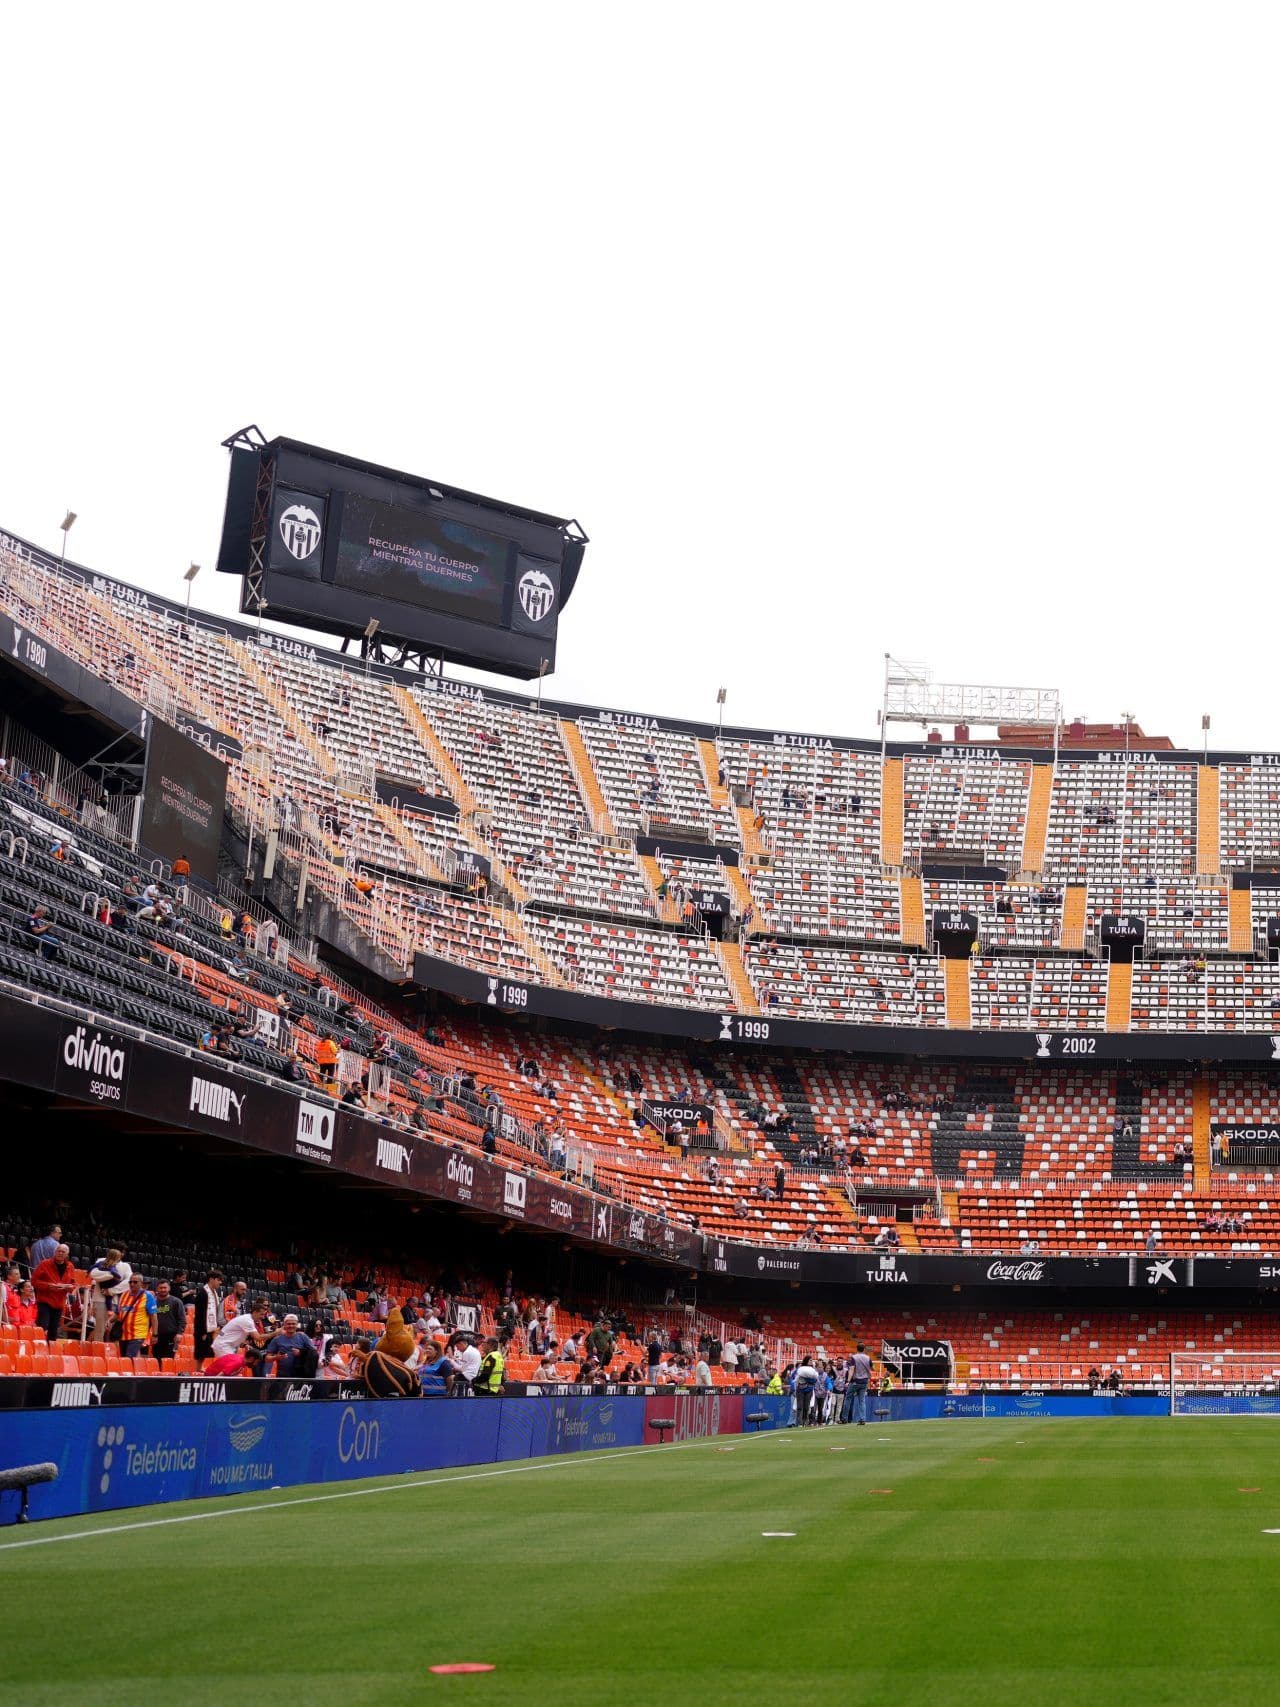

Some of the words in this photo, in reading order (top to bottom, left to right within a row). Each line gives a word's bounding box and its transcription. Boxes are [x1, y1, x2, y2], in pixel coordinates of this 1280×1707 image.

[368, 537, 421, 558] RECUPERA
[424, 552, 437, 562] TU
[438, 556, 479, 573] CUERPO
[373, 549, 423, 569] MIENTRAS
[425, 563, 473, 582] DUERMES
[109, 581, 149, 608] TURIA
[26, 638, 47, 668] 1980
[275, 637, 317, 661] TURIA
[441, 680, 484, 701] TURIA
[615, 713, 660, 731] TURIA
[790, 735, 833, 750] TURIA
[957, 748, 1001, 759] TURIA
[1114, 752, 1157, 763] TURIA
[694, 901, 722, 912] TURIA
[941, 920, 970, 931] TURIA
[1108, 925, 1137, 935] TURIA
[502, 984, 528, 1007] 1999
[737, 1020, 769, 1039] 1999
[64, 1026, 125, 1081] divina
[1062, 1037, 1096, 1054] 2002
[90, 1079, 121, 1100] seguros
[189, 1076, 231, 1122] PUMA
[301, 1112, 313, 1135] TM
[1223, 1129, 1280, 1140] SKODA
[376, 1138, 403, 1173] PUMA
[447, 1153, 474, 1186] divina
[550, 1199, 573, 1219] SKODA
[714, 1258, 727, 1272] TURIA
[987, 1261, 1045, 1281] Coca-Cola
[866, 1270, 908, 1282] TURIA
[883, 1346, 947, 1358] SKODA
[52, 1383, 92, 1407] PUMA
[192, 1383, 226, 1402] TURIA
[337, 1405, 380, 1463] Con
[125, 1440, 196, 1476] Telefónica
